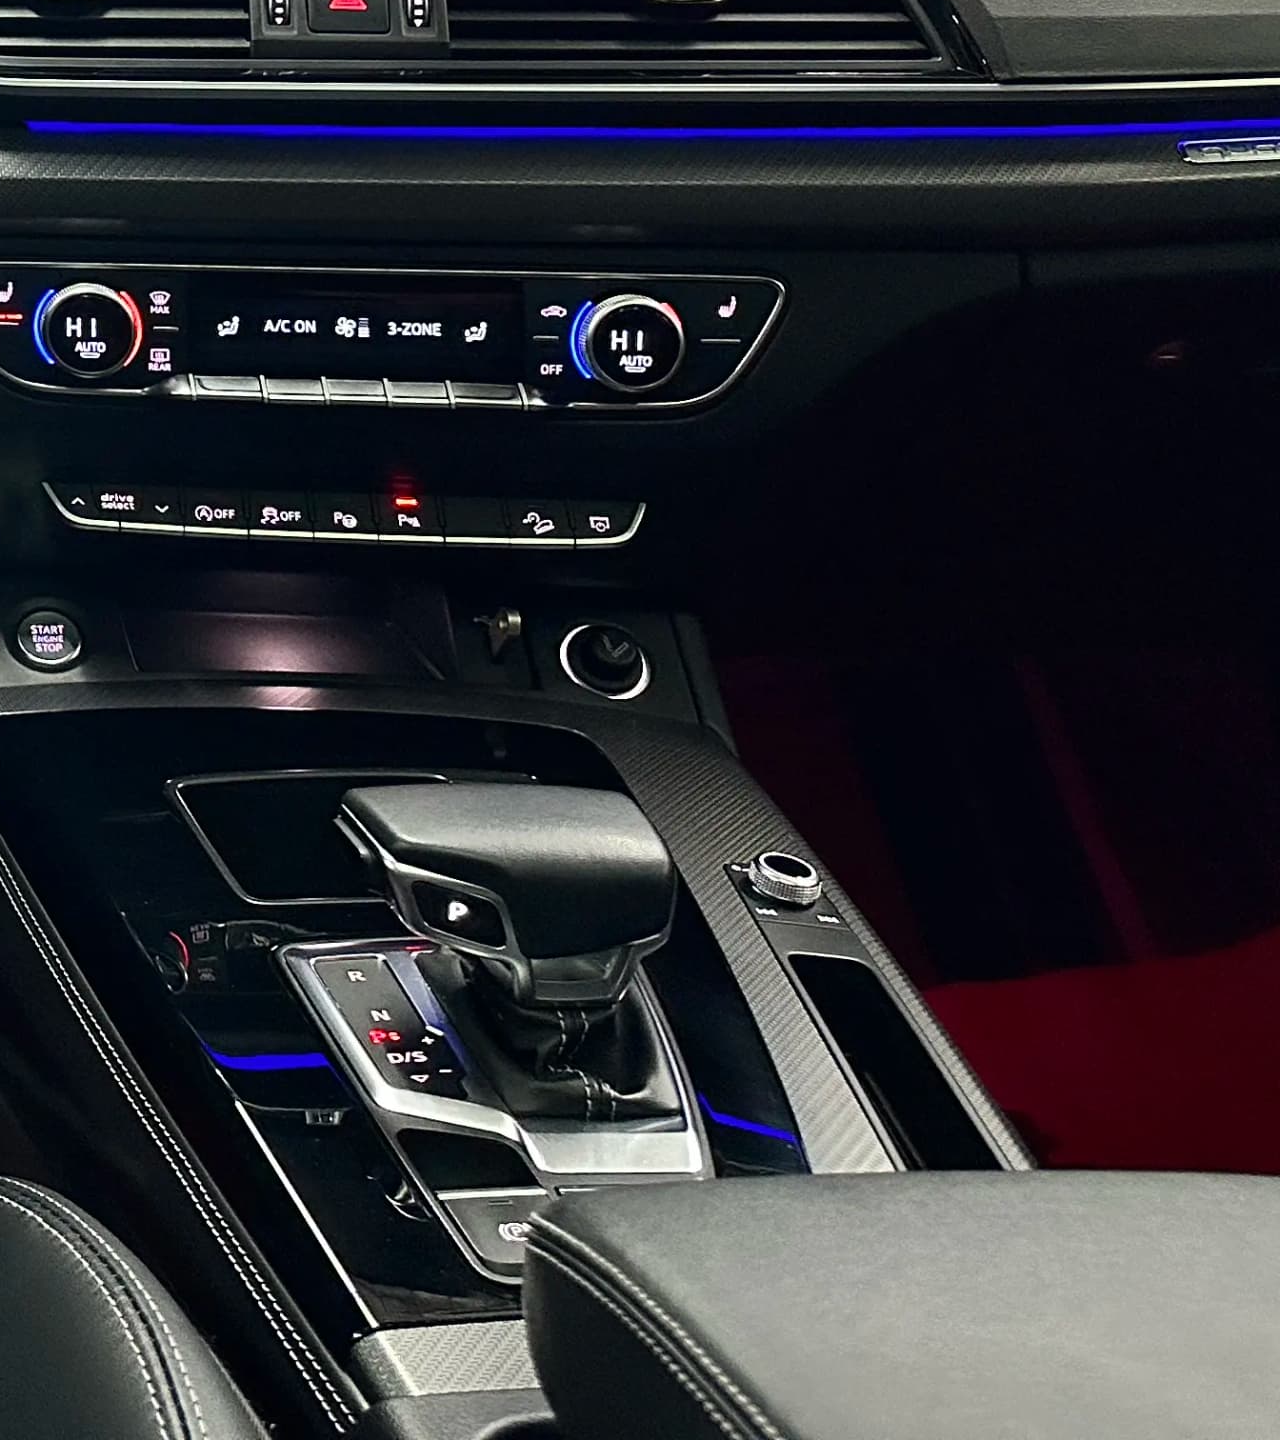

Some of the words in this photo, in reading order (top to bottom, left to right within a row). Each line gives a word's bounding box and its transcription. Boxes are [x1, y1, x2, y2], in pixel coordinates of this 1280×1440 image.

[150, 304, 171, 315] MAX
[263, 319, 291, 333] A/C
[294, 319, 317, 334] ON
[386, 321, 442, 337] 3-ZONE
[74, 341, 107, 353] AUTO
[148, 362, 171, 372] REAR
[619, 355, 653, 367] AUTO
[540, 363, 564, 376] OFF
[100, 492, 135, 503] drive
[100, 501, 136, 511] select
[213, 508, 236, 520] OFF
[279, 510, 302, 522] OFF
[29, 624, 65, 635] START
[32, 634, 65, 643] ENGINE
[34, 642, 64, 653] STOP
[447, 900, 469, 921] P
[347, 970, 367, 983] R
[370, 1009, 392, 1022] N
[386, 1050, 429, 1064] D/S
